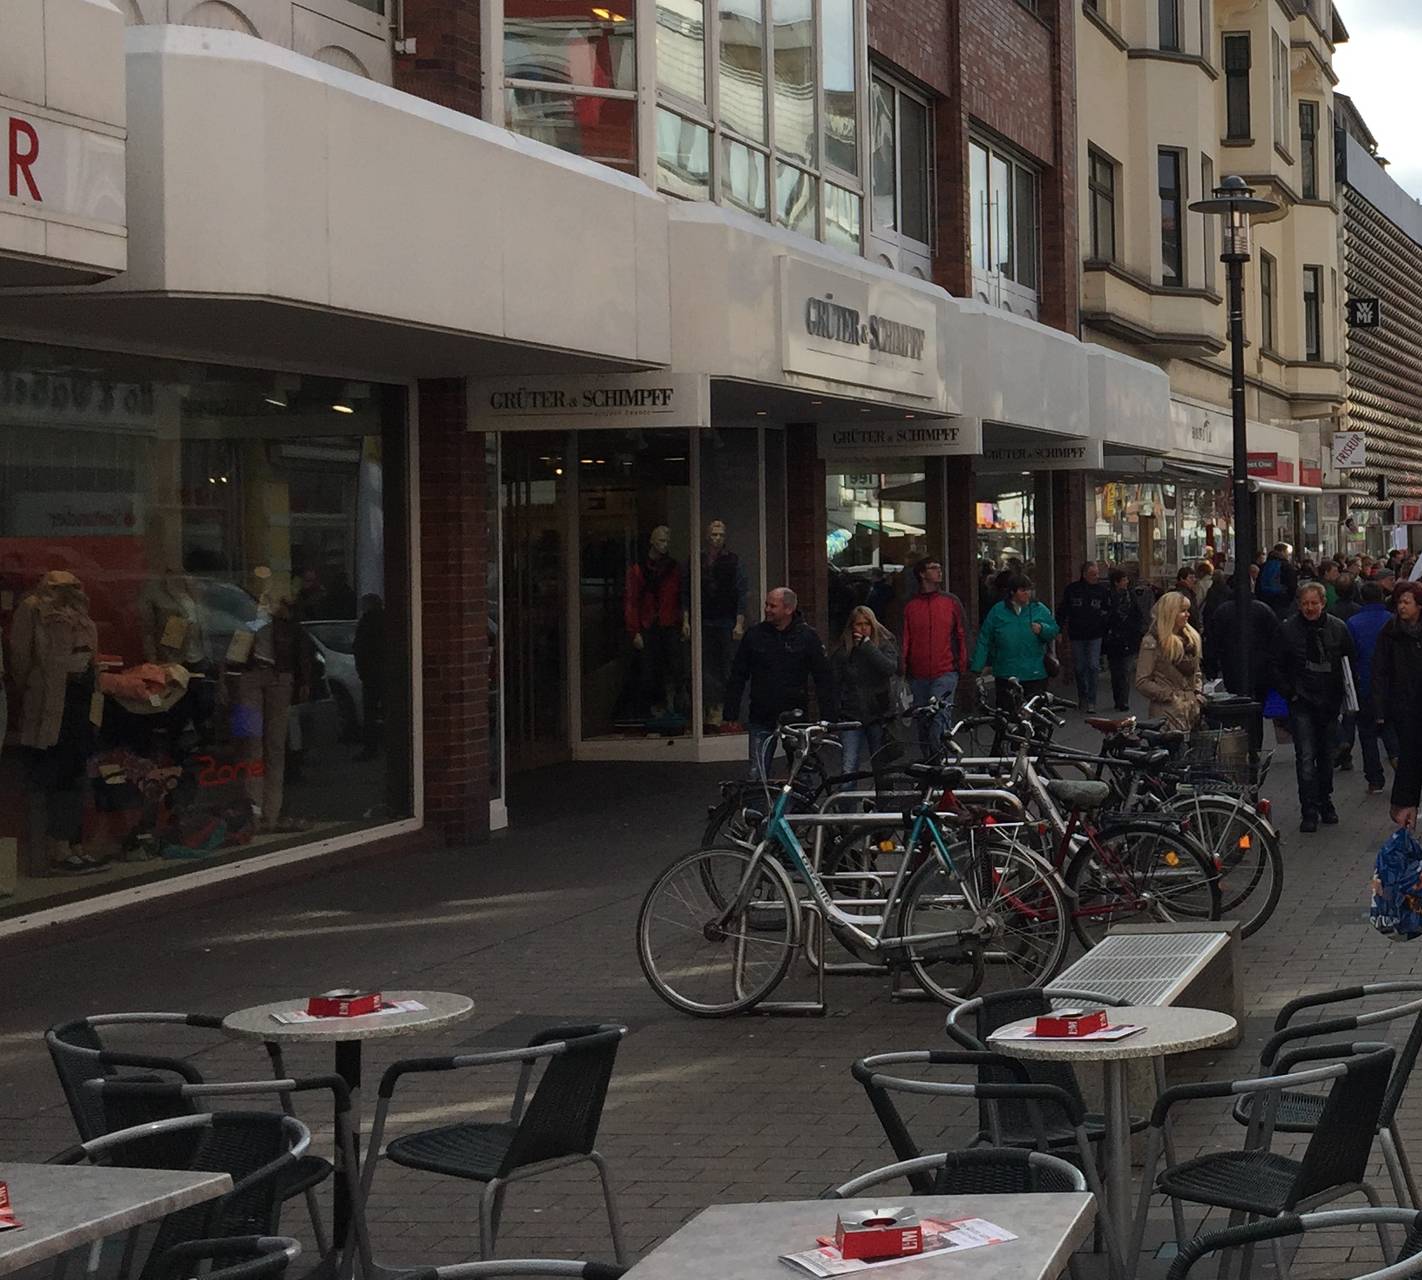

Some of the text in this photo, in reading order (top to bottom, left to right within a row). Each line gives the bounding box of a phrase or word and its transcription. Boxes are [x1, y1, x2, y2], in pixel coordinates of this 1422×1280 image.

[9, 117, 42, 201] R
[806, 293, 860, 346] GRÜTER
[869, 315, 925, 360] SCHIMPFF
[490, 387, 674, 410] GRÜTER & SCHIMPFF
[832, 427, 885, 444] GRÜTER
[896, 427, 960, 442] SCHIMPFF
[1335, 433, 1361, 465] FRISEUR
[191, 754, 266, 785] Zone
